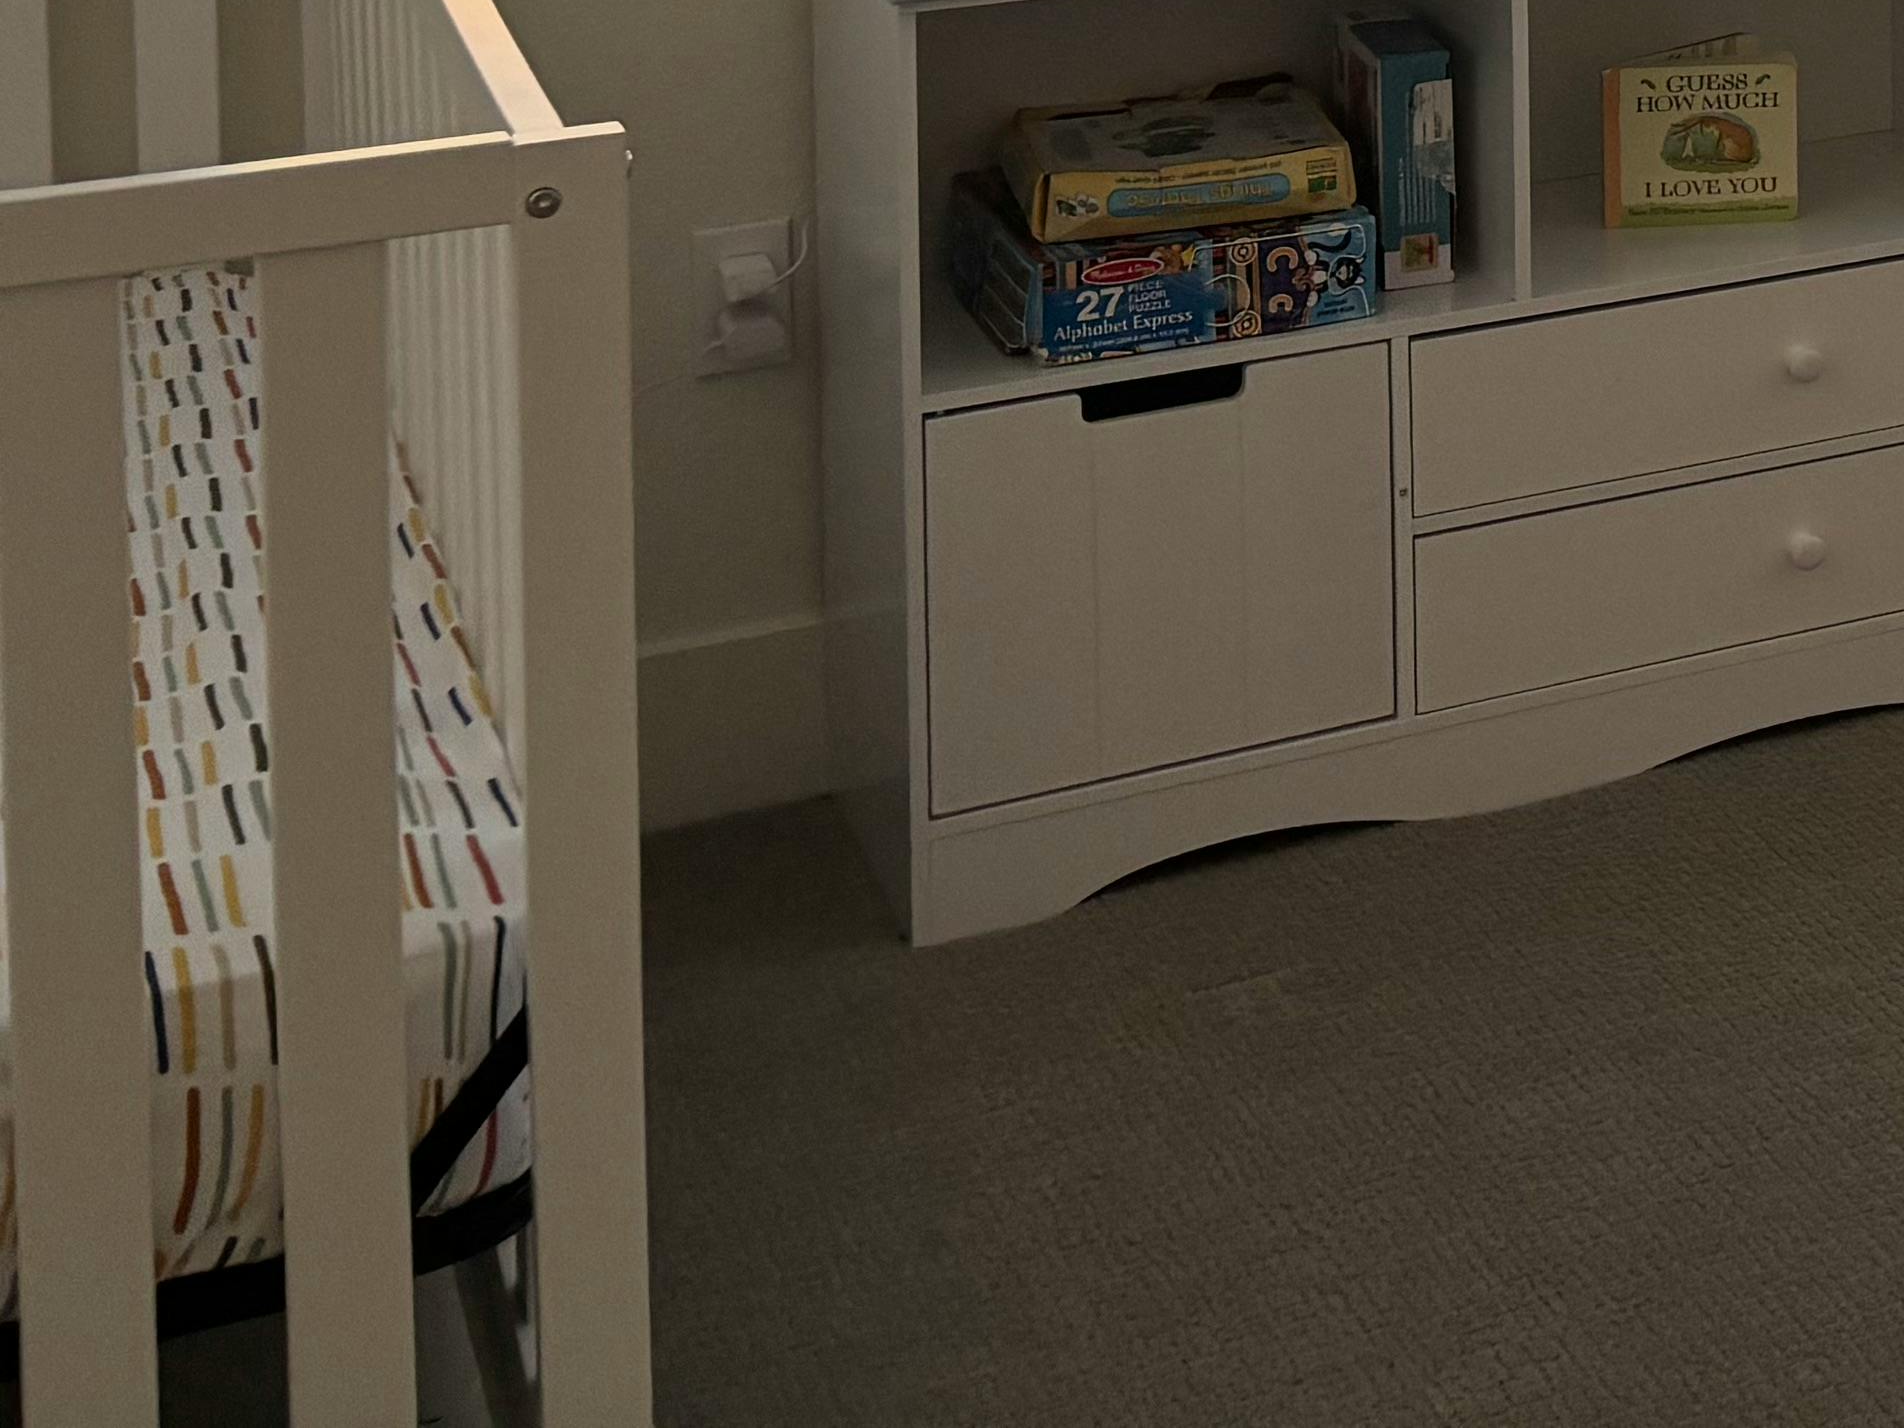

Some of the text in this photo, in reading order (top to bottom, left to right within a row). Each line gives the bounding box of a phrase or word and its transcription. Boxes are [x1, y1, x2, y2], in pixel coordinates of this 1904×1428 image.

[1666, 73, 1748, 93] GUESS
[1636, 91, 1779, 113] HOW MUCH
[1644, 176, 1778, 198] I LOVE YOU
[1075, 286, 1126, 323] 27
[1128, 289, 1167, 304] FLOOR
[1129, 299, 1172, 313] PUZZLE
[1053, 318, 1128, 343] Alphabet
[1132, 309, 1193, 333] Express
